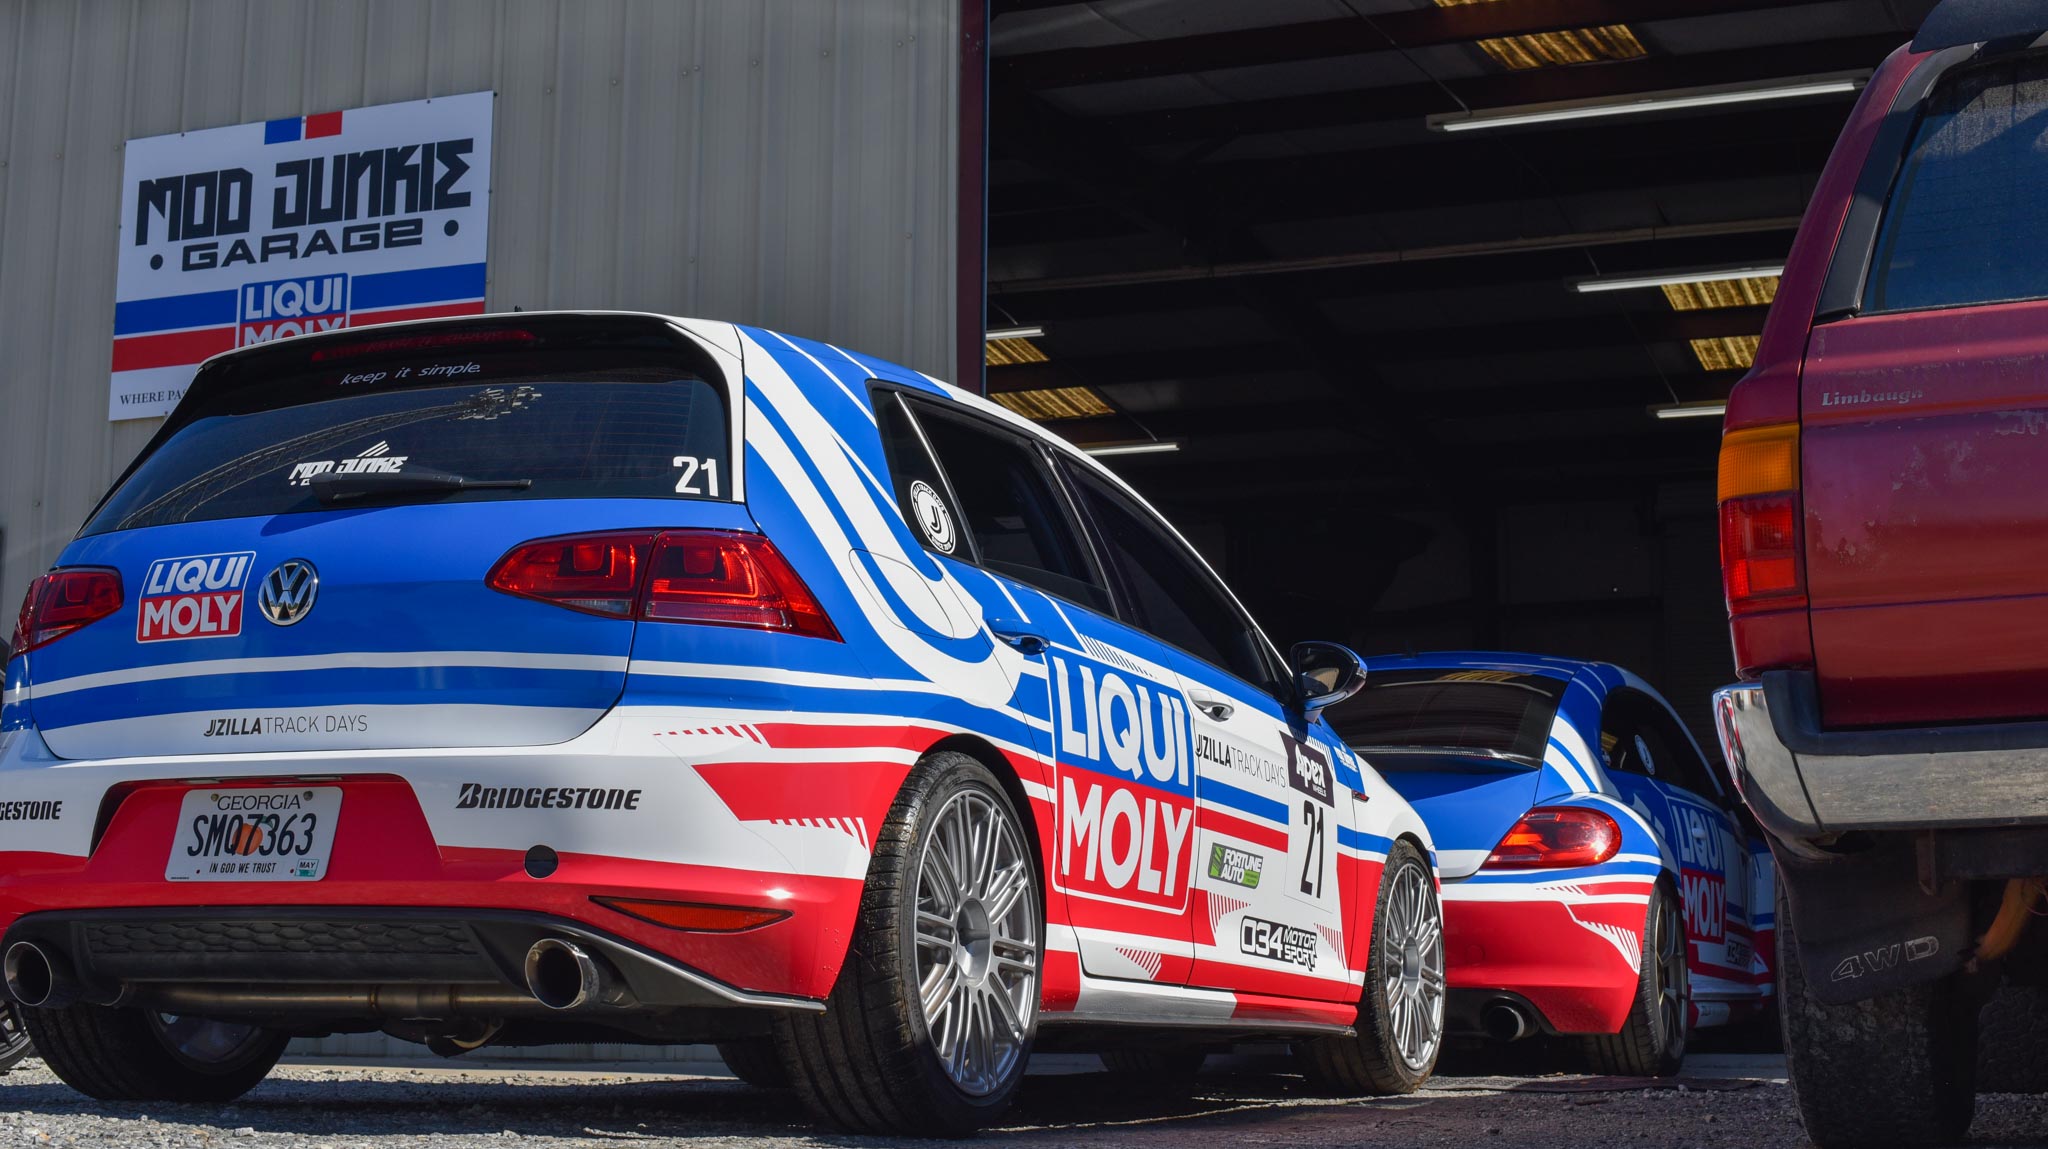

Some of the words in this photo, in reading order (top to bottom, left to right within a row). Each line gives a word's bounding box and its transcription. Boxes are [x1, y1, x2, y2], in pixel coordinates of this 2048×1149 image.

[135, 167, 253, 246] MOD
[272, 137, 474, 229] JUNKIE
[182, 218, 423, 272] GARAGE
[245, 277, 343, 320] LIQUI
[340, 371, 387, 385] keep
[395, 367, 411, 378] it
[120, 391, 165, 405] WHERE
[1821, 389, 1924, 407] Limbaugh
[335, 456, 409, 474] JUNKIE
[673, 456, 719, 497] 21
[147, 556, 249, 595] LIQUI
[142, 594, 241, 637] MOLY
[325, 714, 368, 733] DAYS
[1055, 656, 1190, 787] LIQUI
[1264, 760, 1286, 788] DAYS
[217, 794, 301, 811] GEORGIA
[455, 783, 642, 810] BRIDGESTONE
[187, 813, 317, 857] SMQ7363
[1060, 776, 1194, 897] MOLY
[1300, 799, 1324, 899] 21
[1672, 805, 1724, 871] LIQUI
[209, 862, 218, 874] IN
[220, 862, 236, 874] GOD
[238, 862, 250, 874] WE
[252, 862, 277, 874] TRUST
[300, 861, 316, 869] MAY
[1220, 863, 1245, 884] AUTO
[1223, 848, 1263, 873] FORTUNE
[1683, 874, 1725, 938] MOLY
[1241, 918, 1284, 959] 034
[1283, 928, 1317, 951] MOTOR
[1284, 944, 1316, 969] SPORT
[1831, 936, 1939, 981] 4WD
